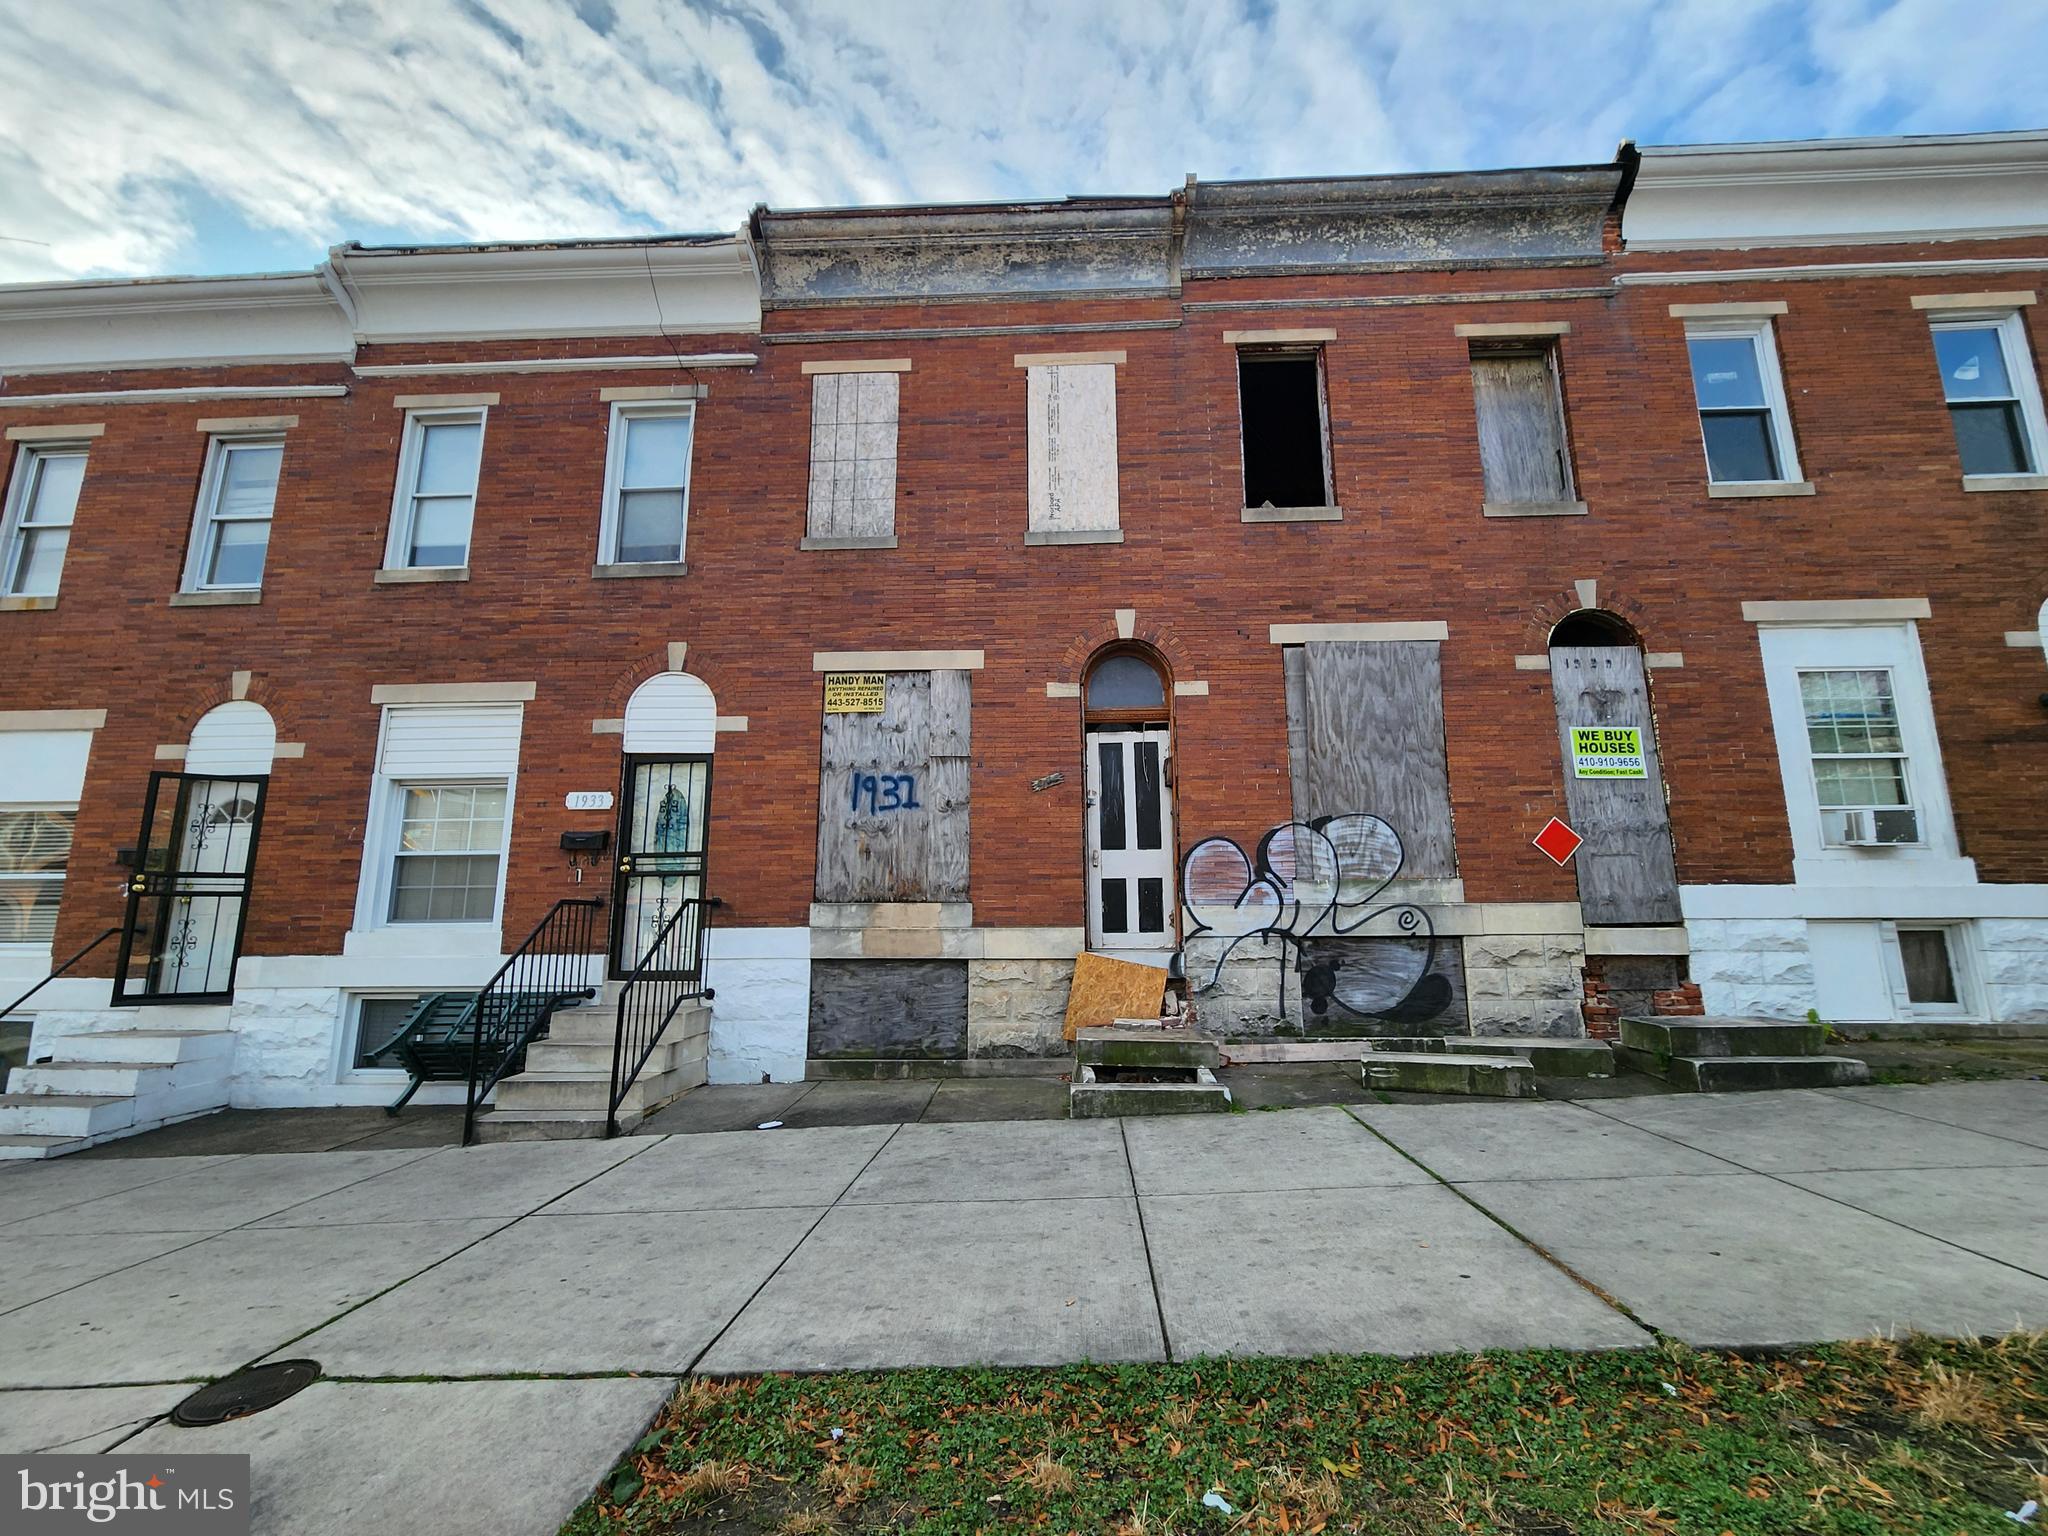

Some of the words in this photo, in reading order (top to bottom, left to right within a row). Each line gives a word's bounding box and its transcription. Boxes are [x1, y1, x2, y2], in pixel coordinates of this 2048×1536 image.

[828, 676, 860, 685] HANDY
[863, 676, 884, 685] MAN
[827, 698, 884, 706] 443-527-8515
[1578, 730, 1600, 741] WE
[1604, 730, 1633, 741] BUY
[1579, 742, 1636, 753] HOUSES
[1578, 757, 1641, 767] 410-910-9656
[575, 794, 605, 808] 1933
